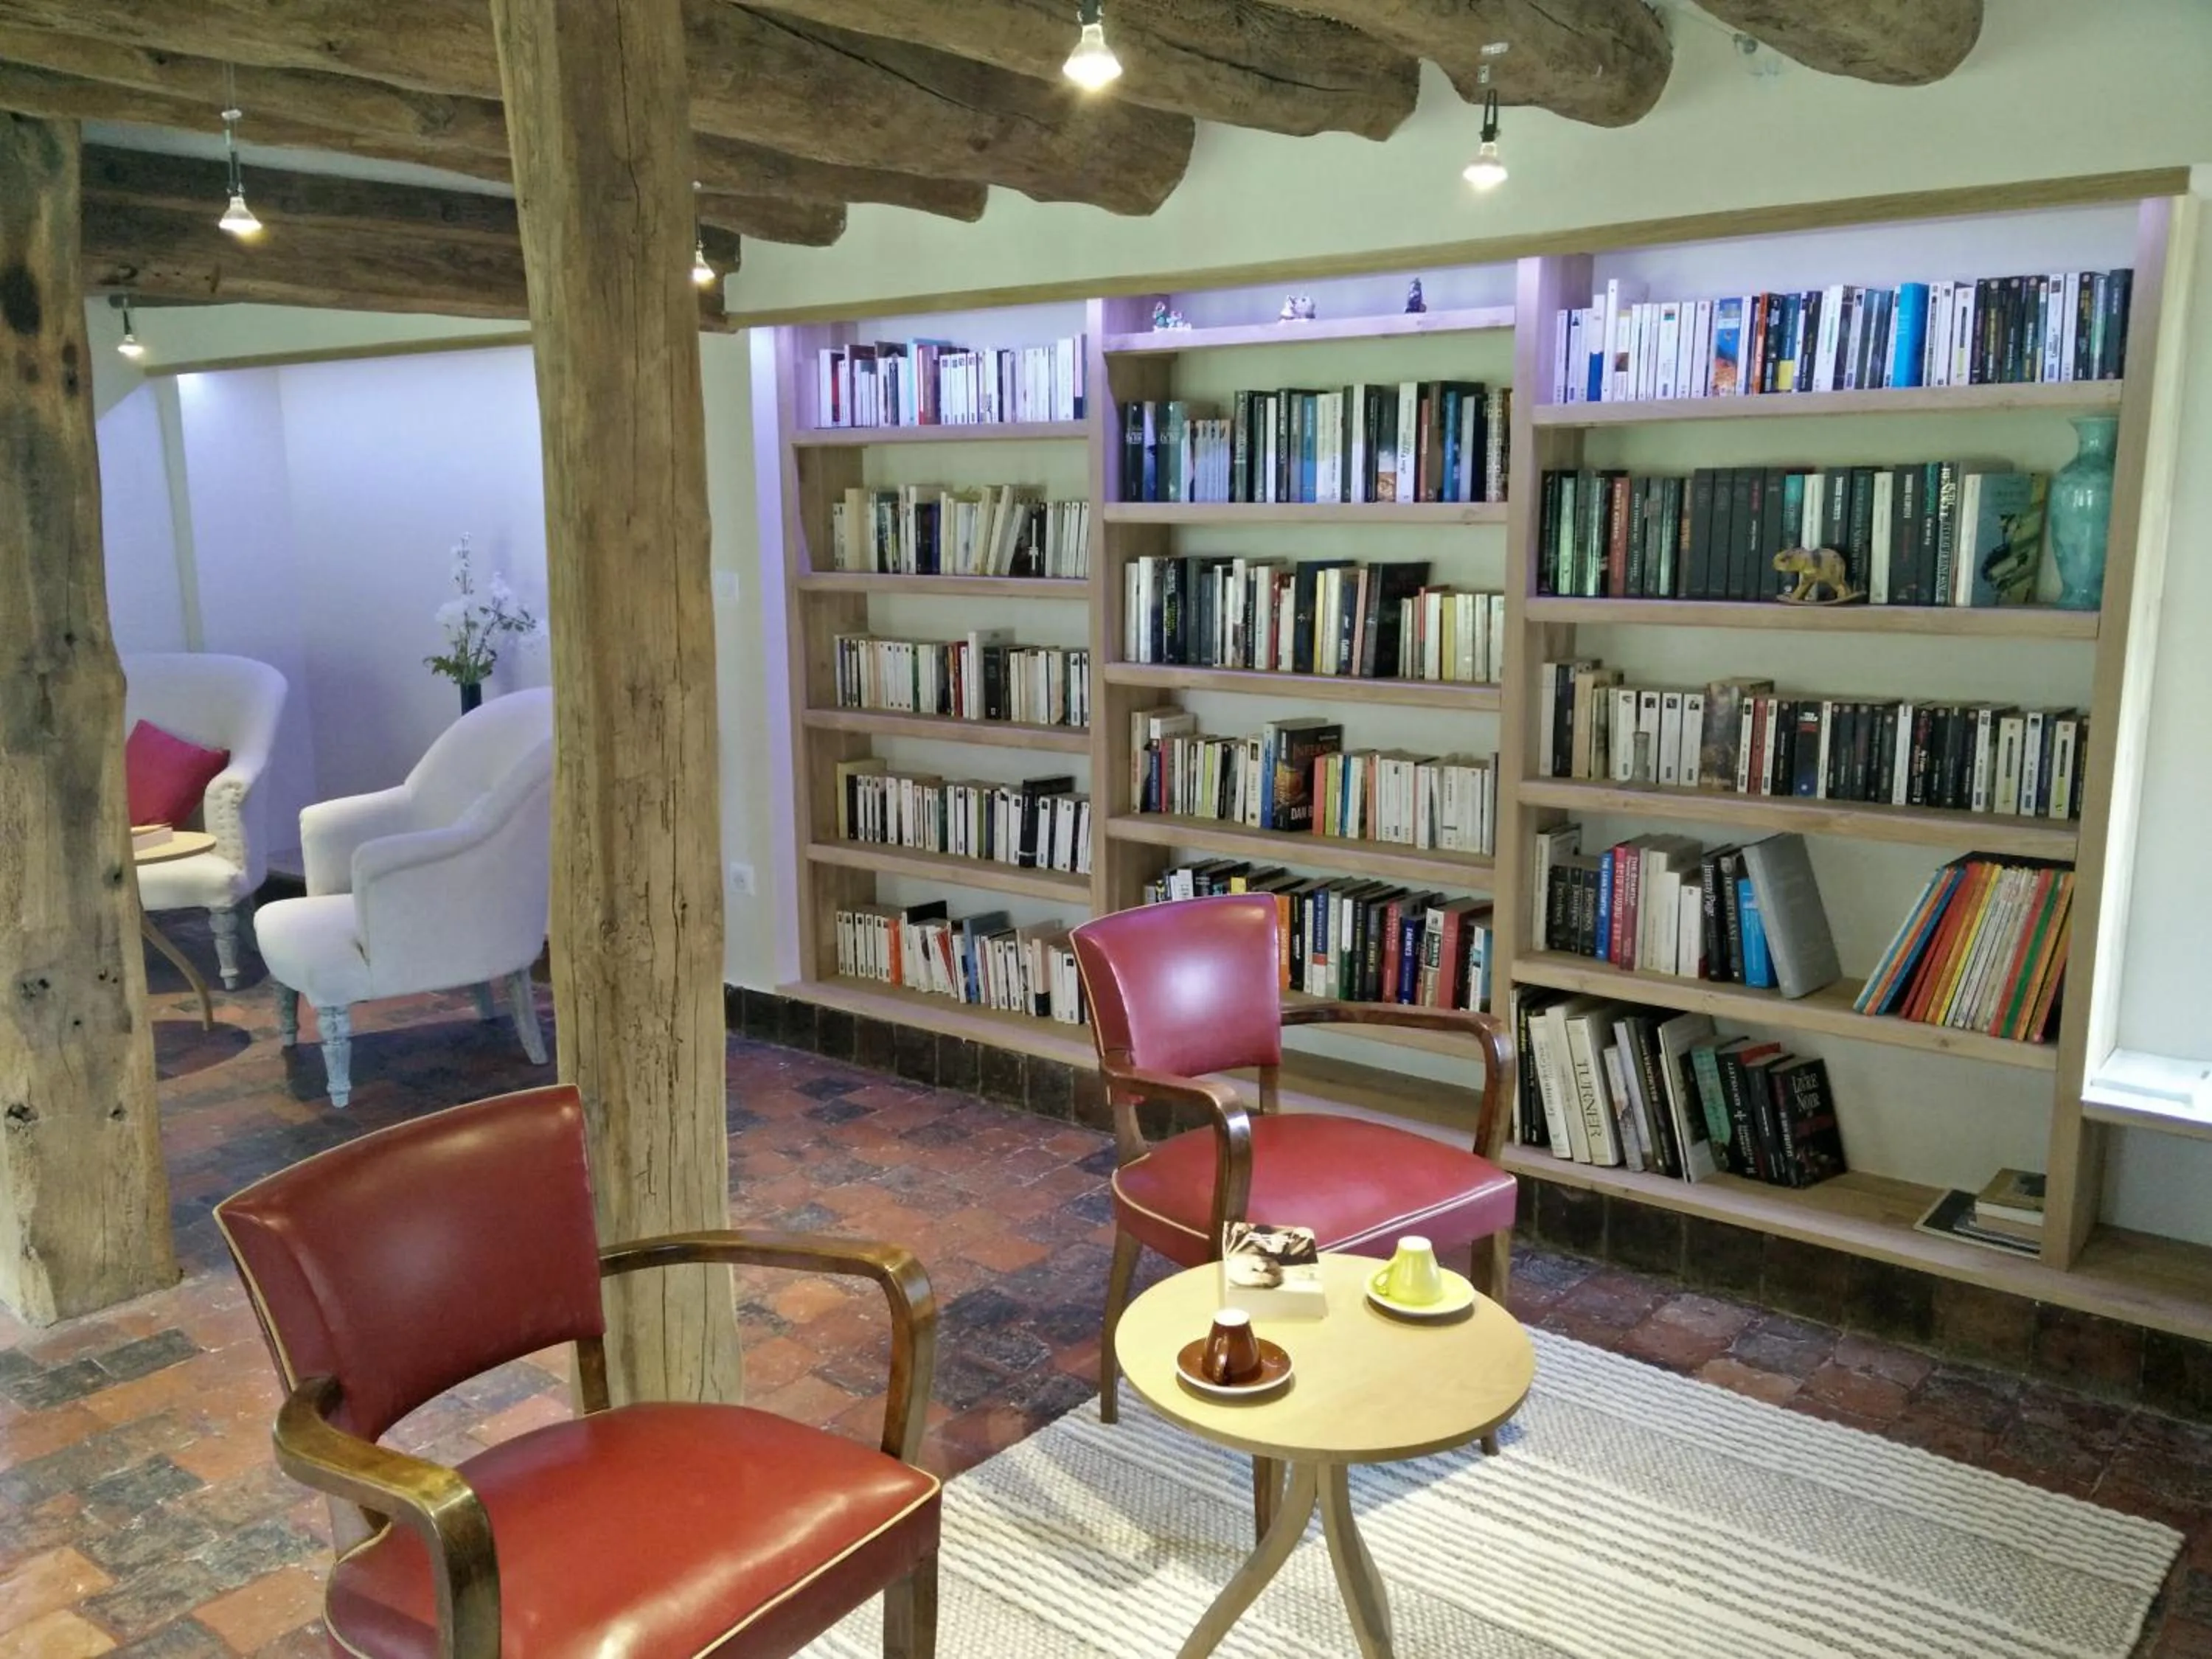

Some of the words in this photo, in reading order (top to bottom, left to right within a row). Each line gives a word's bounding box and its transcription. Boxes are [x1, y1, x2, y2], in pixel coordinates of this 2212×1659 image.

[1291, 806, 1307, 820] DAN
[1703, 863, 1714, 895] Jimmy
[1576, 1062, 1602, 1138] TURNER
